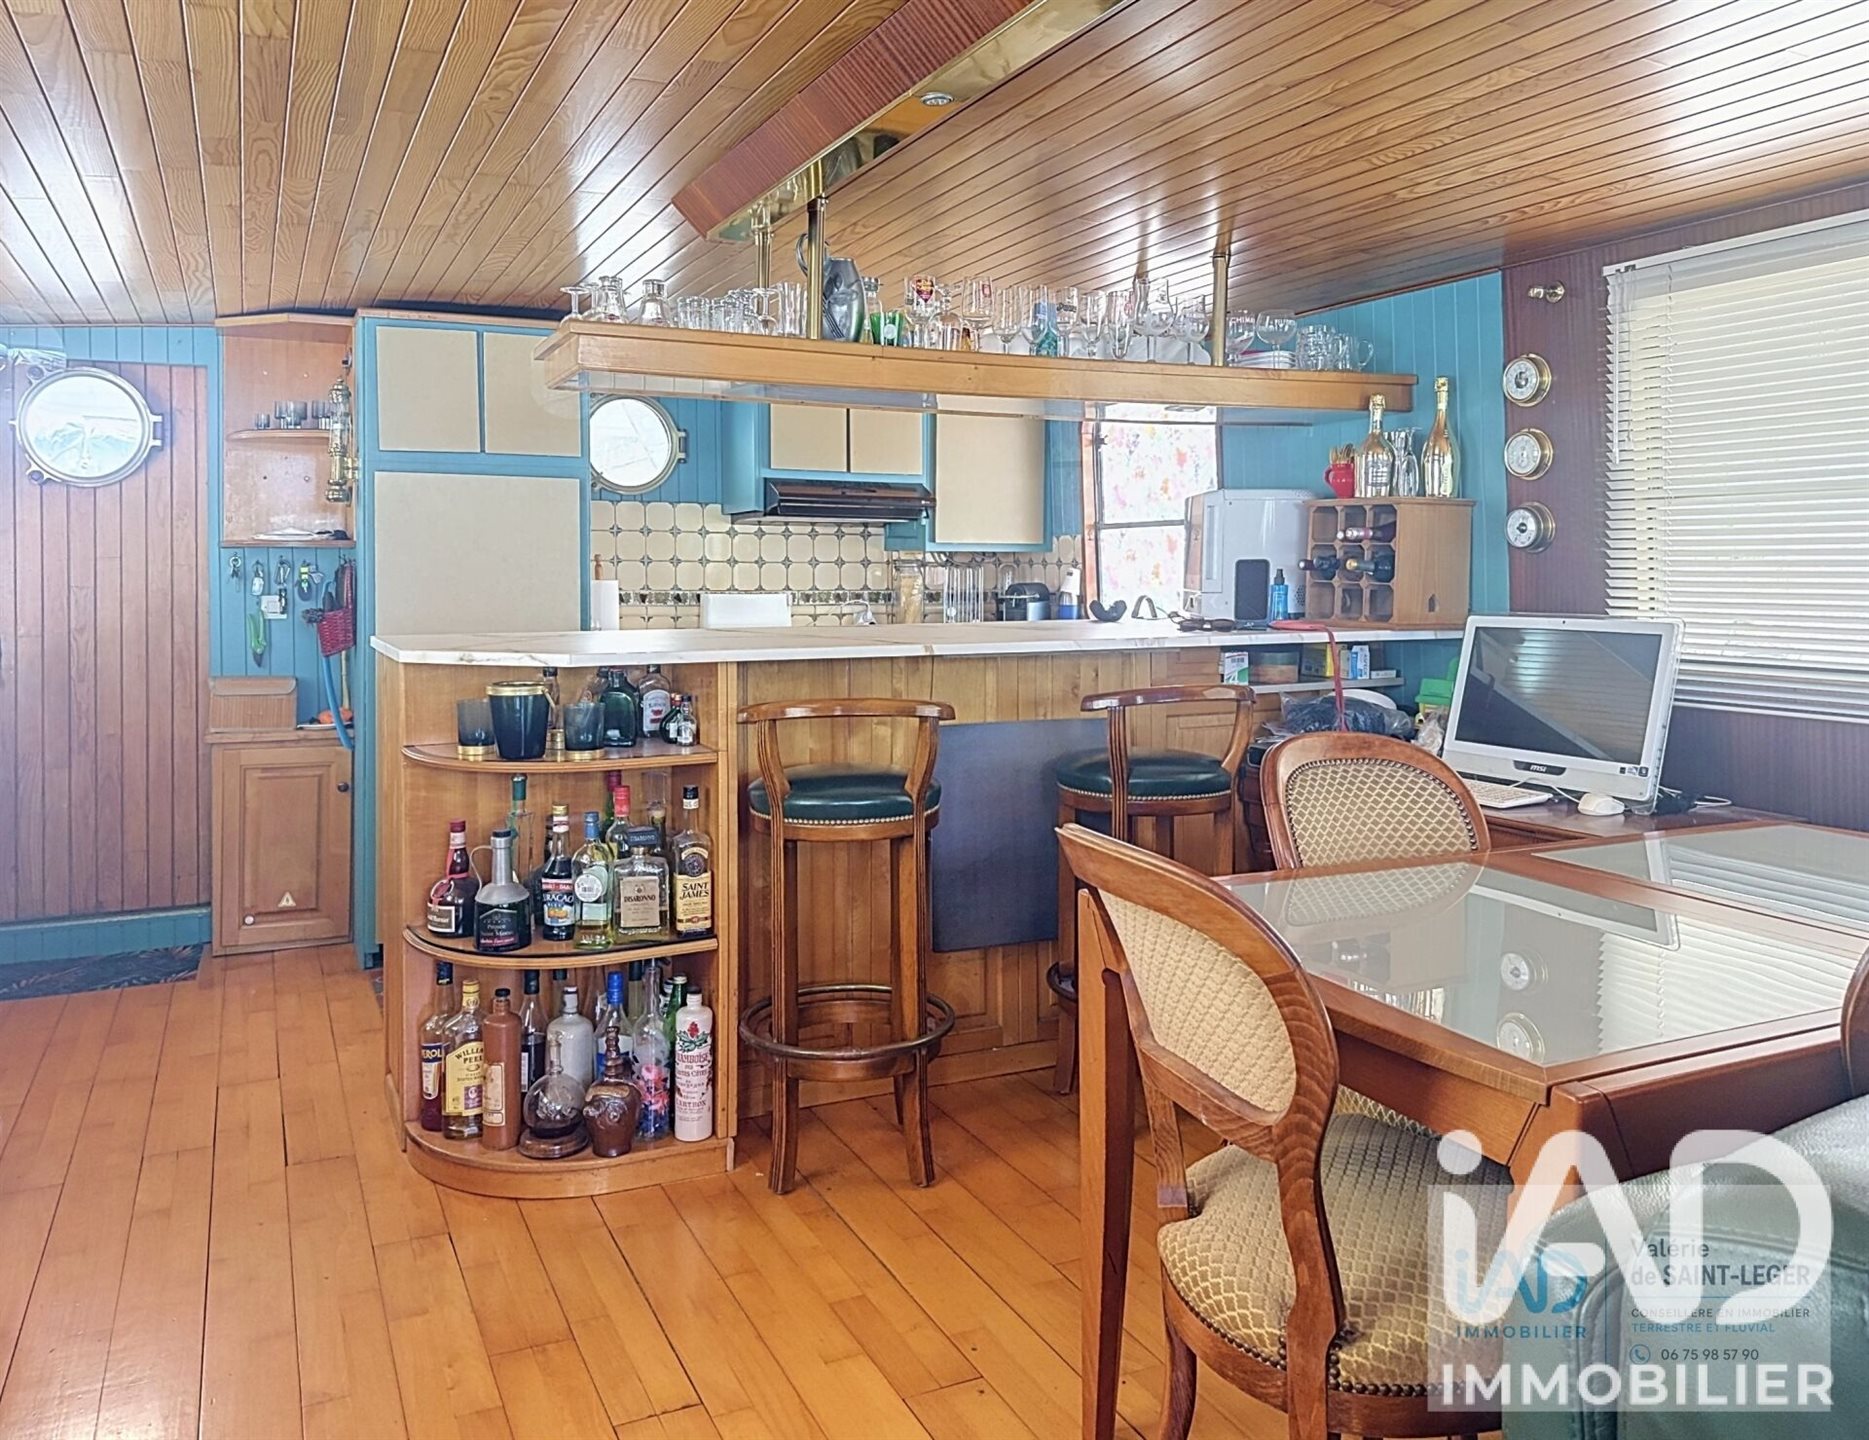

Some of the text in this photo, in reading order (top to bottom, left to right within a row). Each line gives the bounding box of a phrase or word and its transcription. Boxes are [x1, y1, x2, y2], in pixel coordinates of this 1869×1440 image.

[1530, 764, 1547, 772] msi
[682, 882, 708, 892] SAINT
[623, 894, 656, 903] DISARONNO
[680, 890, 709, 900] JAMES
